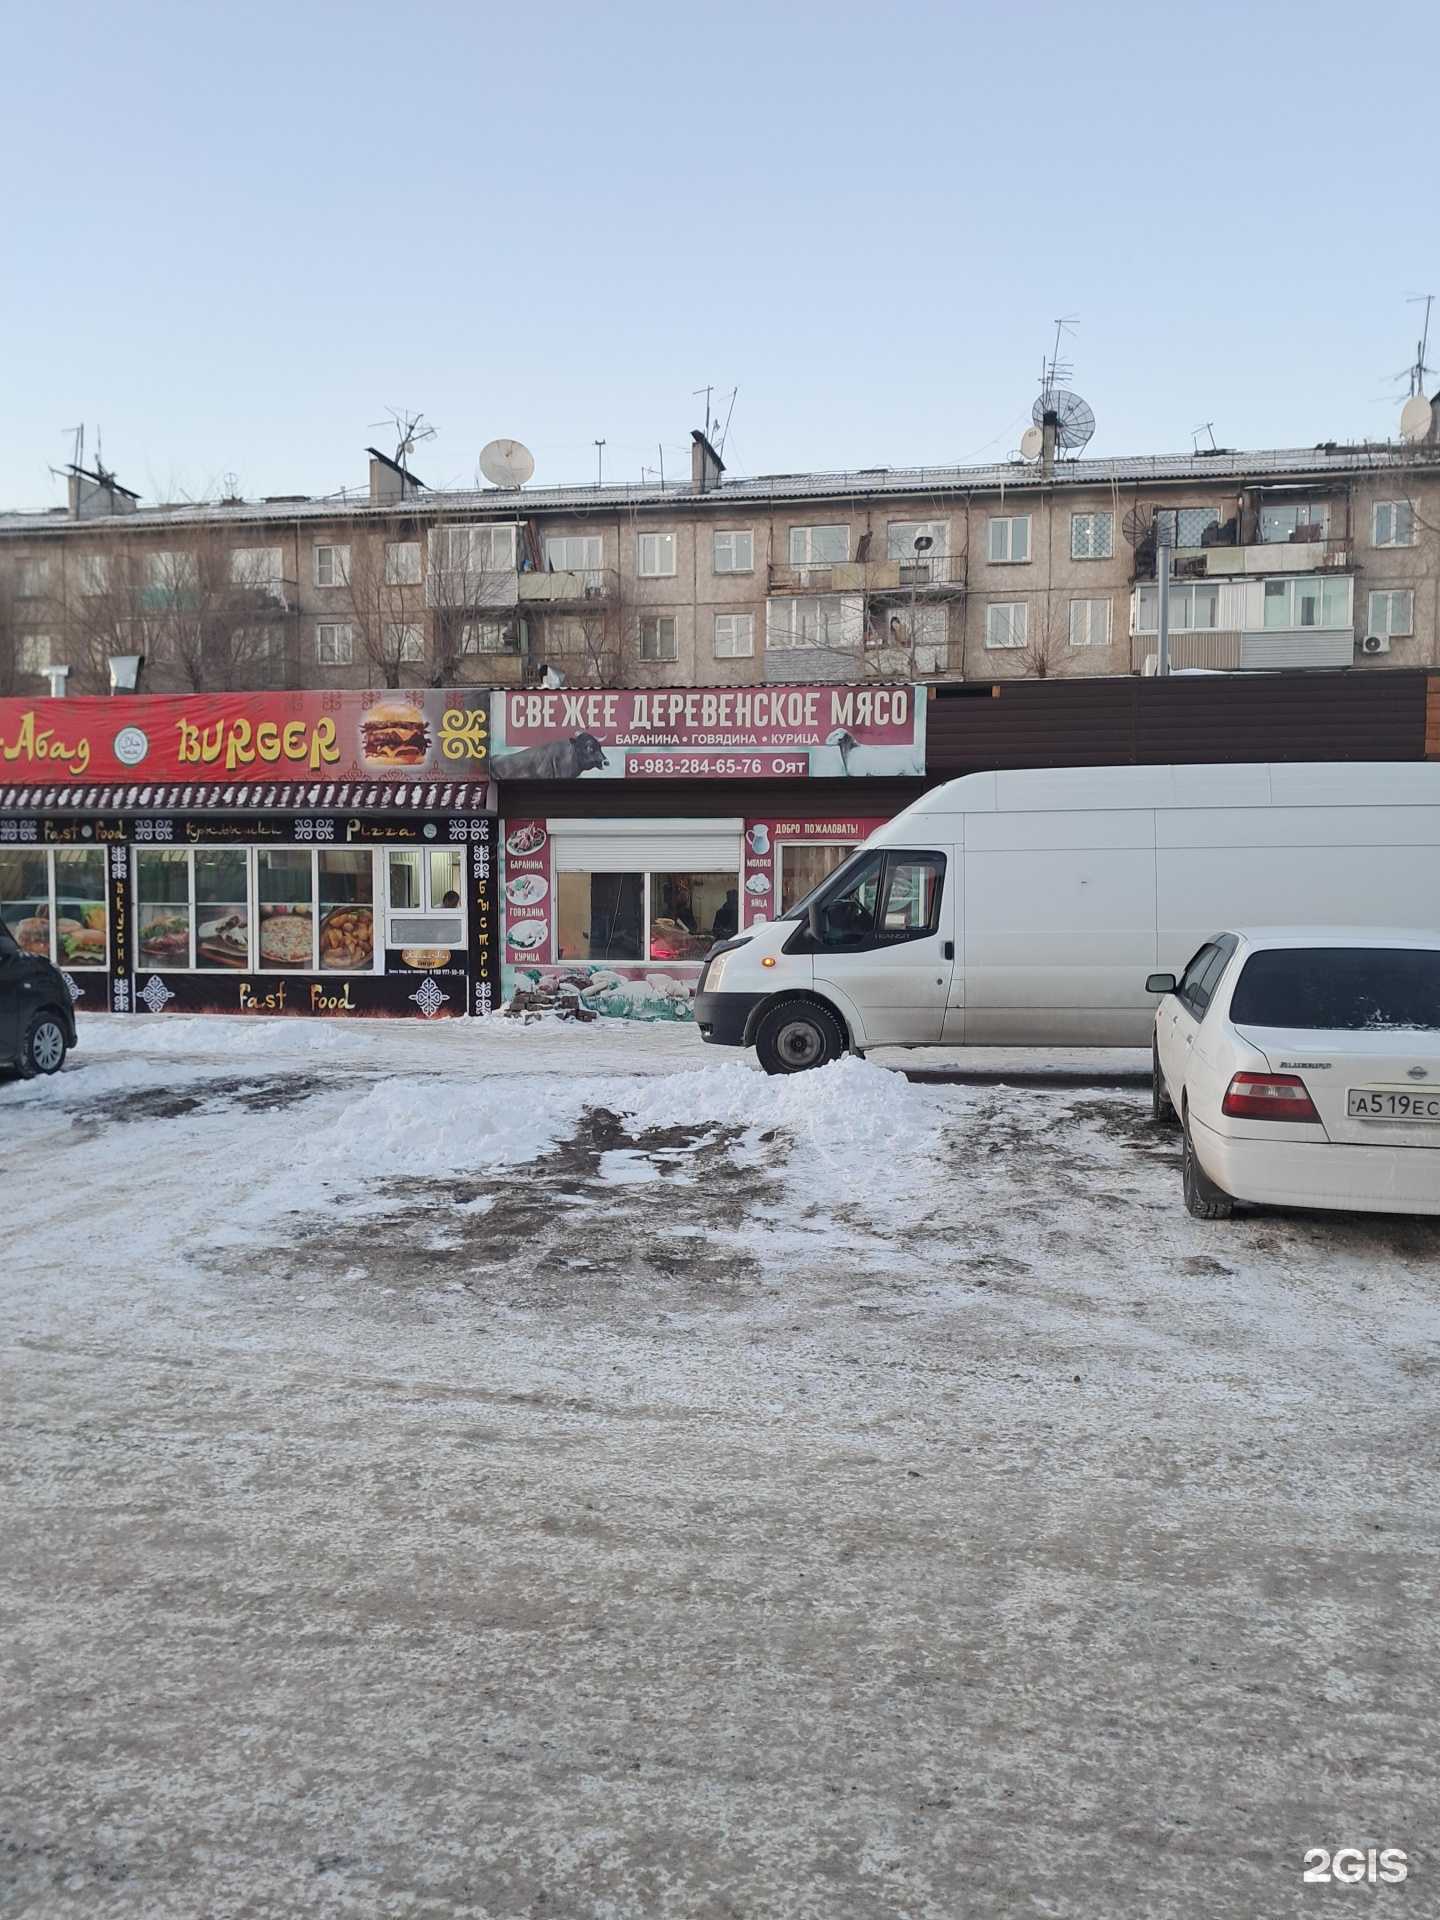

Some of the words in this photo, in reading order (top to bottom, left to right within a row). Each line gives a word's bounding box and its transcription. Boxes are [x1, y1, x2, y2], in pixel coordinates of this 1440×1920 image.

[511, 694, 619, 729] СВЕЖЕЕ
[630, 692, 820, 730] ДЕРЕВЕНСКОЕ
[831, 690, 907, 727] МЯСО
[175, 716, 341, 770] BURGER
[615, 735, 680, 745] БАРАНИНА
[691, 734, 757, 746] ГОВЯДИНА
[771, 733, 820, 745] КУРИЦА
[629, 759, 762, 774] 8-983-284-65-76
[772, 758, 806, 774] Оят
[775, 823, 801, 834] ДОБРО
[804, 823, 859, 834] ПОЖАЛОВАТЬ!
[510, 860, 544, 870] БАРАНИНА
[509, 907, 545, 918] ГОВЯДИНА
